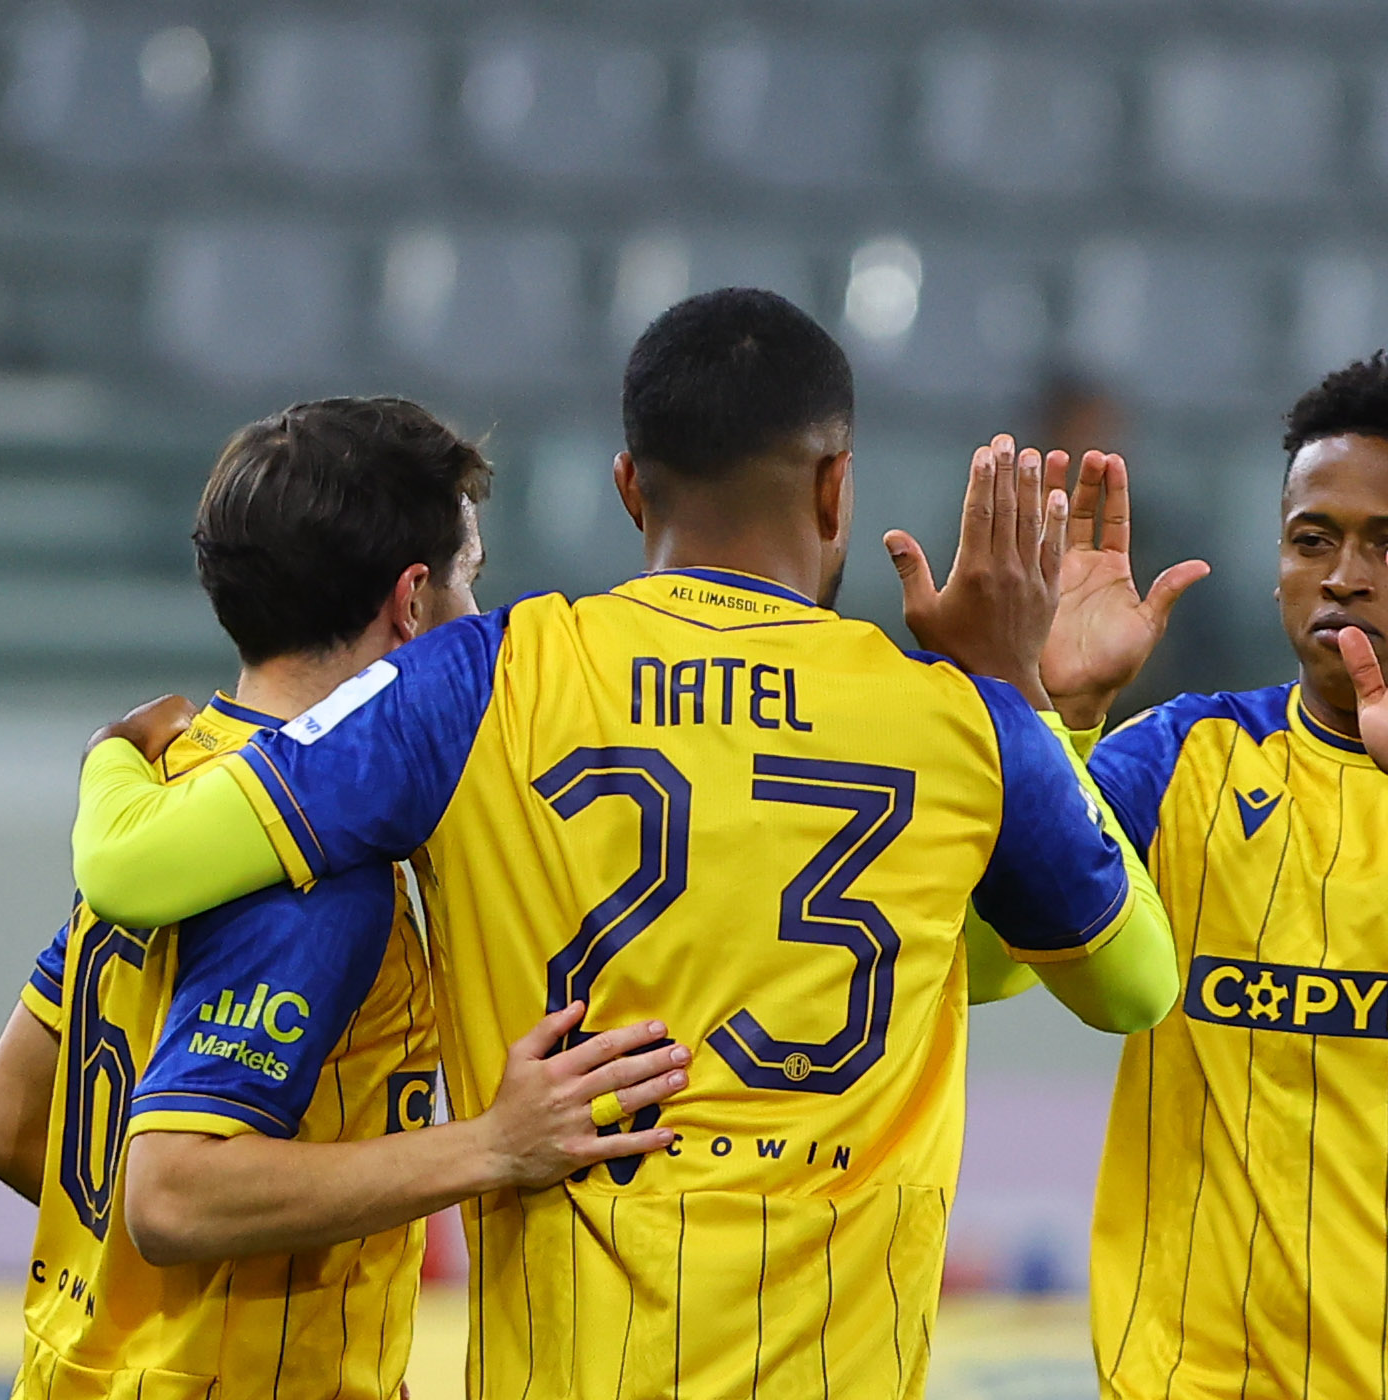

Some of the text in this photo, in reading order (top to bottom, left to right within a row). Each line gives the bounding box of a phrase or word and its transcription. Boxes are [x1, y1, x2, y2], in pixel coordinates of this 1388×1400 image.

[669, 585, 695, 602] AEL
[698, 590, 760, 615] LIMASSOL
[630, 656, 814, 733] NATEL
[530, 745, 917, 1096] 23
[60, 912, 154, 1243] 6
[187, 1031, 290, 1082] Markets
[665, 1132, 852, 1171] COWIN
[31, 1258, 97, 1319] COWN
